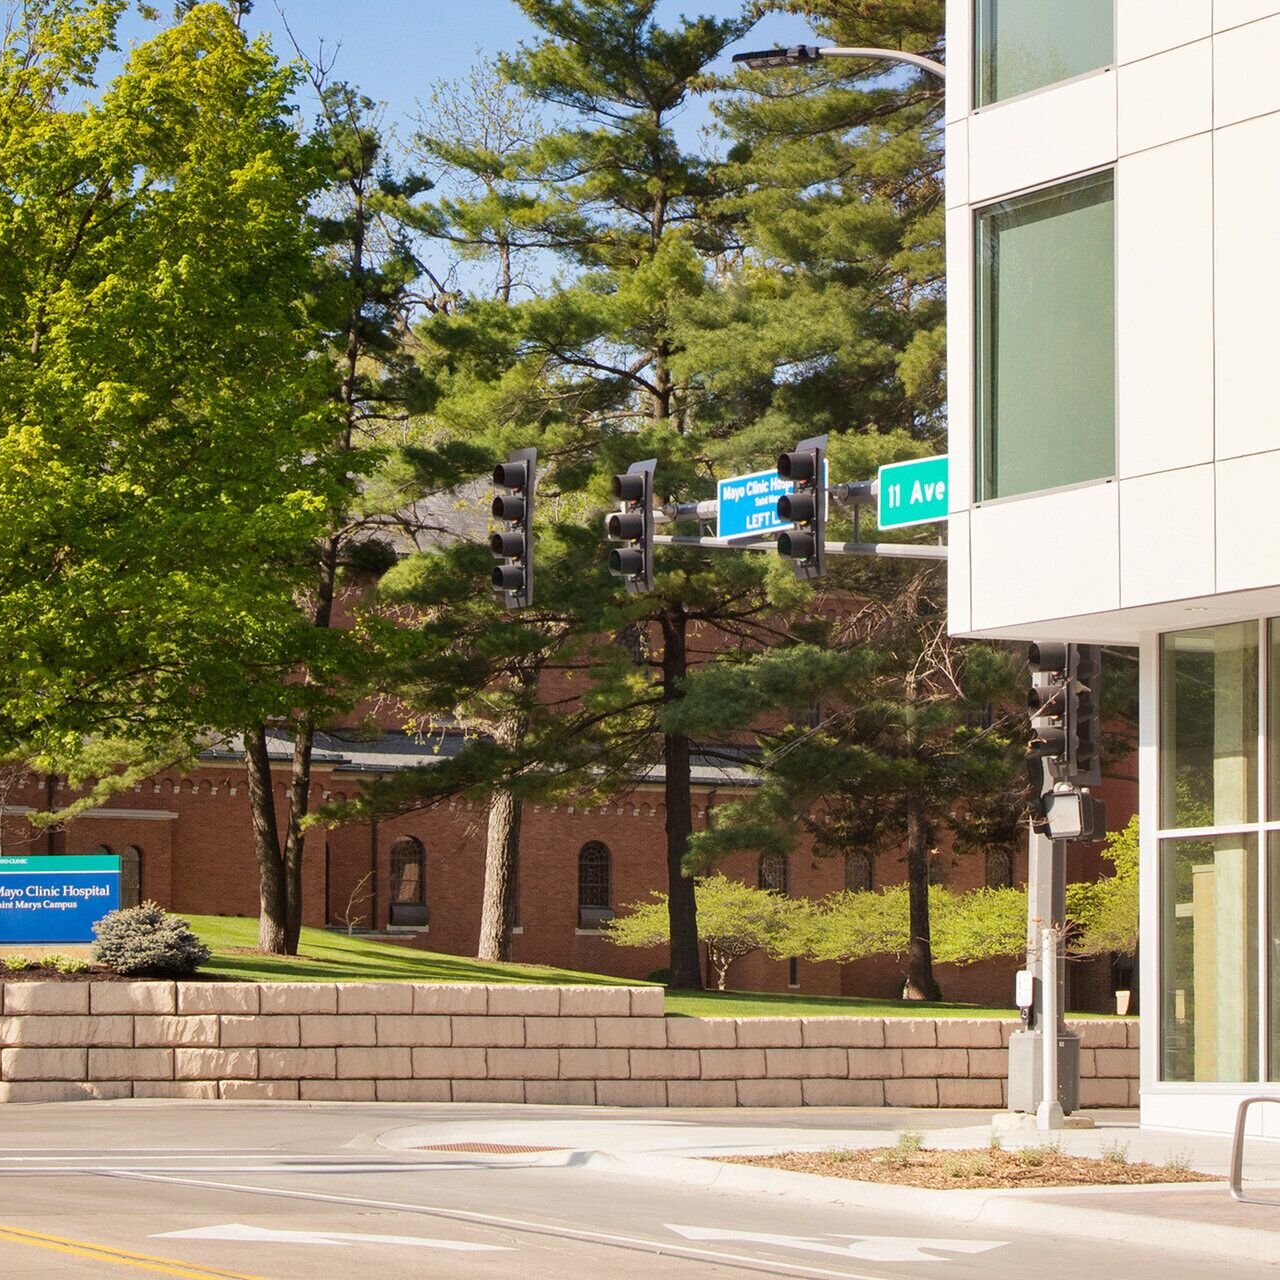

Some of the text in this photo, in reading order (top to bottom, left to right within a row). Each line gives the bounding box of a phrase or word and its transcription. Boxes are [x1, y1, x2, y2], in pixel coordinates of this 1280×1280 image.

[723, 486, 745, 502] Mayo
[746, 480, 769, 496] Clinic
[888, 480, 946, 508] 11 Ave
[746, 511, 770, 529] LEFT
[25, 885, 60, 897] Clinic
[62, 885, 110, 899] Hospital
[15, 901, 42, 911] Marys
[43, 900, 77, 911] Campus
